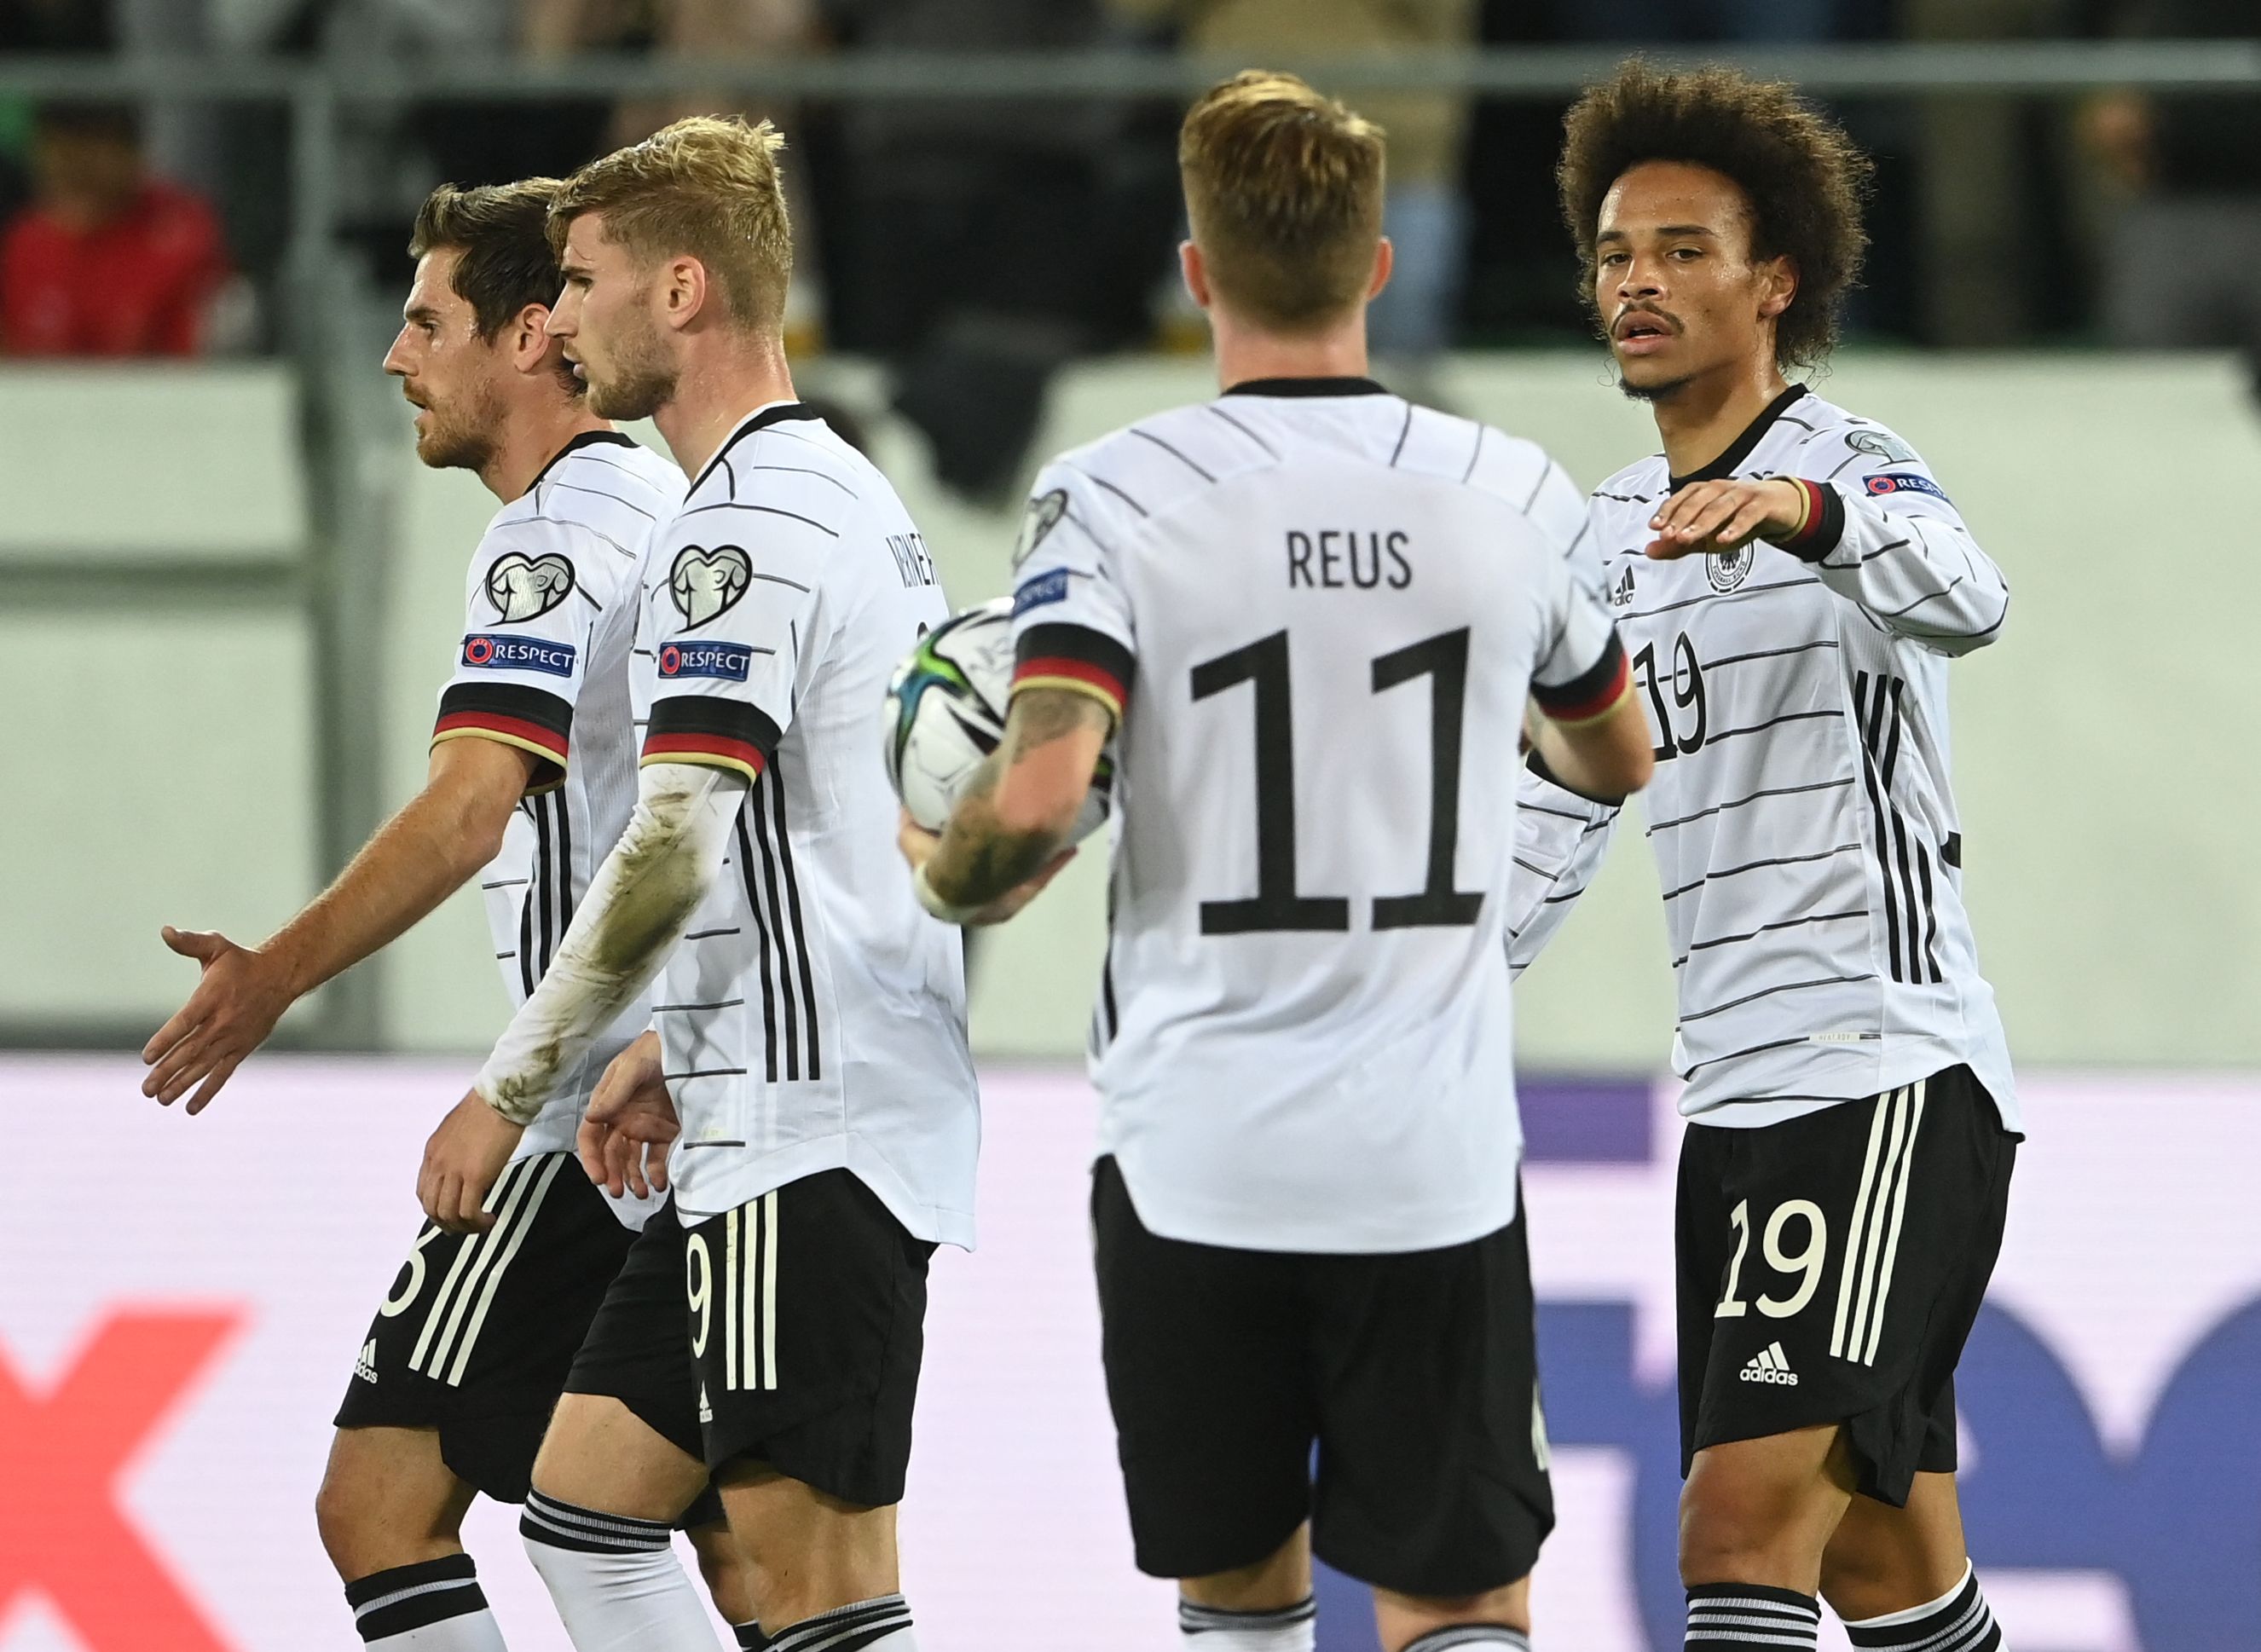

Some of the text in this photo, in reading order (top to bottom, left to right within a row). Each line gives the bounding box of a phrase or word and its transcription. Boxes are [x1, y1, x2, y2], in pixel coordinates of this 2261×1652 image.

[1286, 529, 1413, 590] REUS
[494, 644, 573, 668] RESPECT
[680, 651, 749, 672] RESPECT
[1632, 630, 1707, 762] 19
[1189, 625, 1485, 936] 11
[685, 1233, 713, 1360] 9
[1714, 1198, 1827, 1319] 19
[1739, 1366, 1799, 1386] adidas
